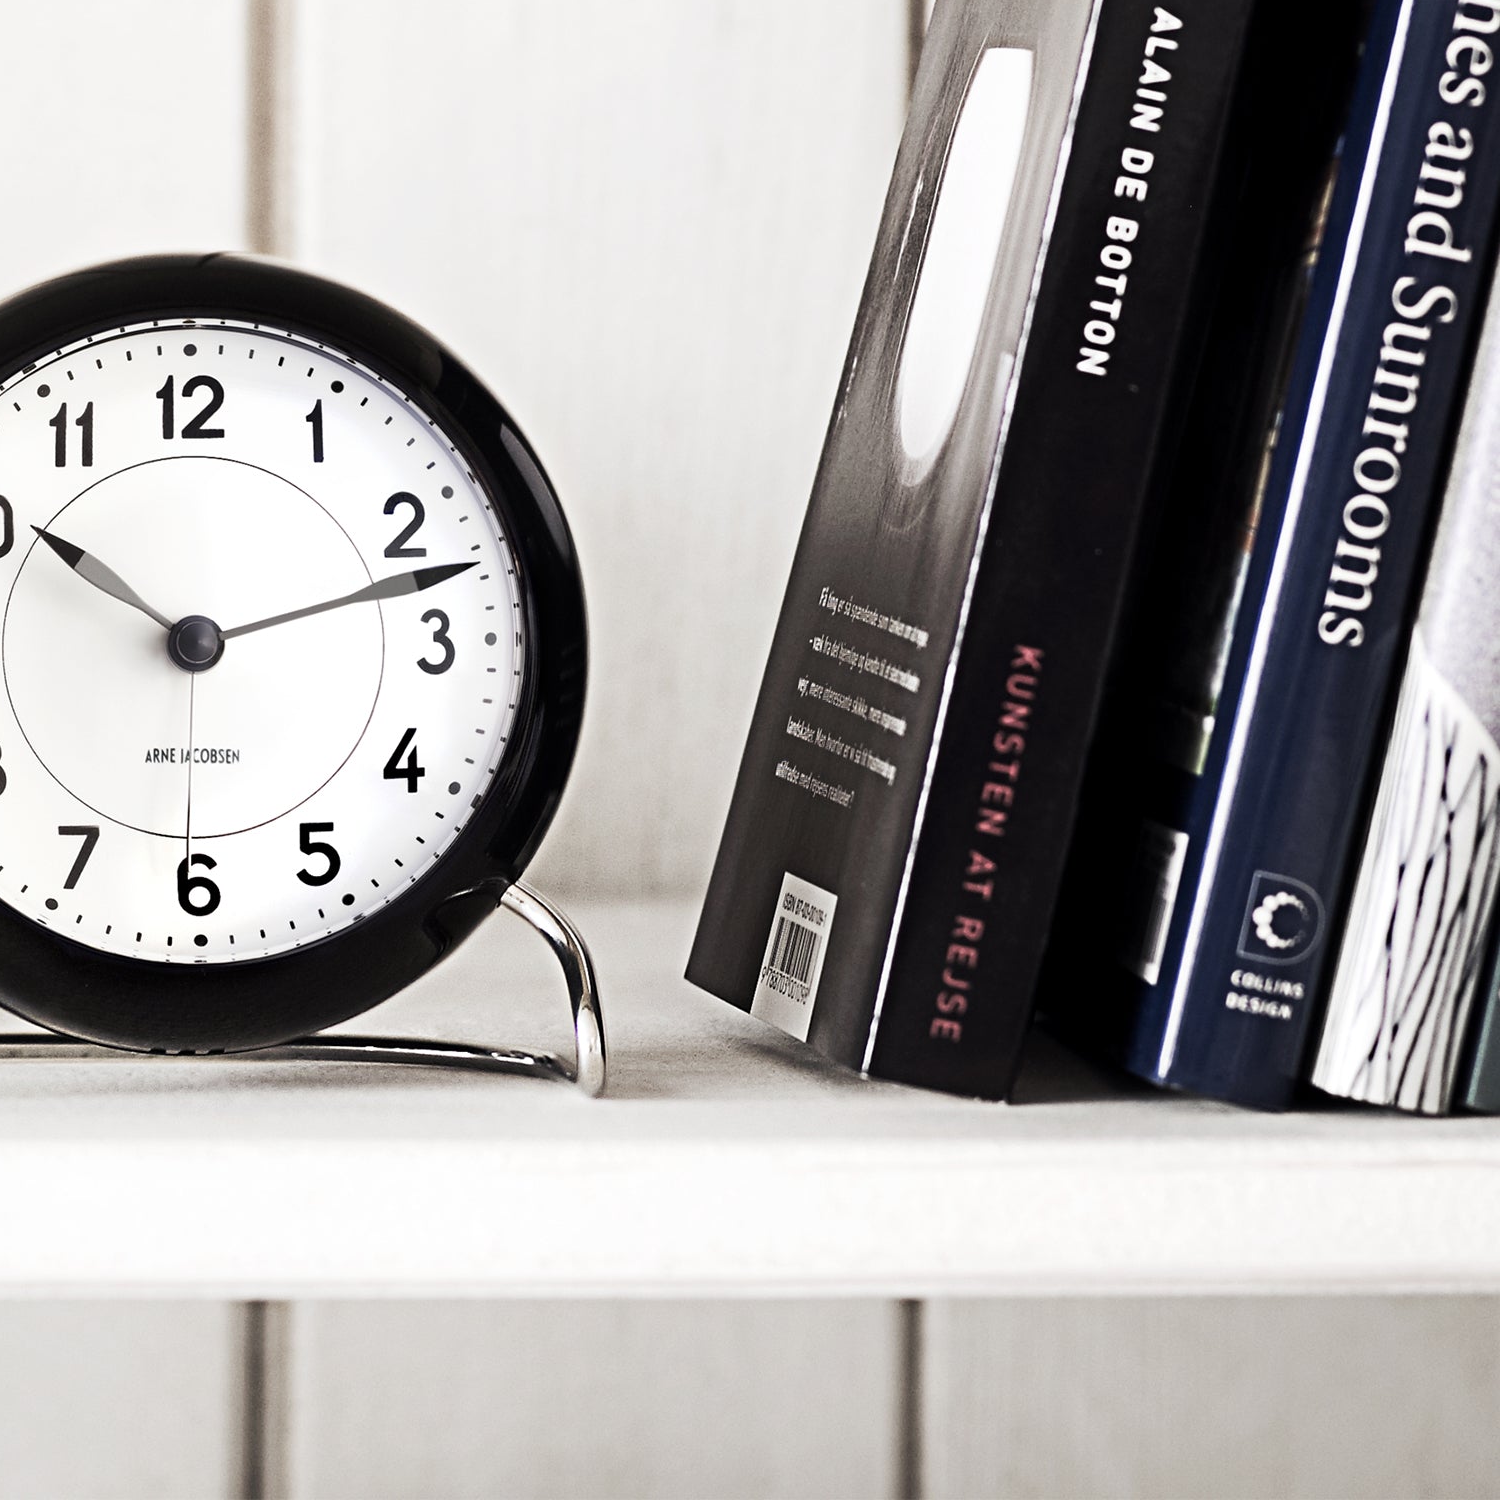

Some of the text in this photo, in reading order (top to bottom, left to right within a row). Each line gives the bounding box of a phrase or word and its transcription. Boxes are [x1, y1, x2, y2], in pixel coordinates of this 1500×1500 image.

[1075, 6, 1184, 377] ALAIN DE BOTTON
[1403, 119, 1474, 264] and
[49, 401, 95, 469] 11
[155, 373, 227, 441] 12
[305, 398, 325, 464] 1
[1317, 275, 1459, 649] Sunrooms
[382, 491, 428, 559] 2
[415, 608, 457, 676] 3
[145, 748, 176, 764] ARNE
[382, 727, 426, 794] 4
[57, 824, 101, 890] 7
[295, 821, 342, 888] 5
[929, 643, 1045, 1044] KUNSTEN AT REJSE
[176, 853, 222, 918] 6
[1225, 991, 1293, 1020] DESIGN
[1230, 968, 1305, 1000] COLLINS
